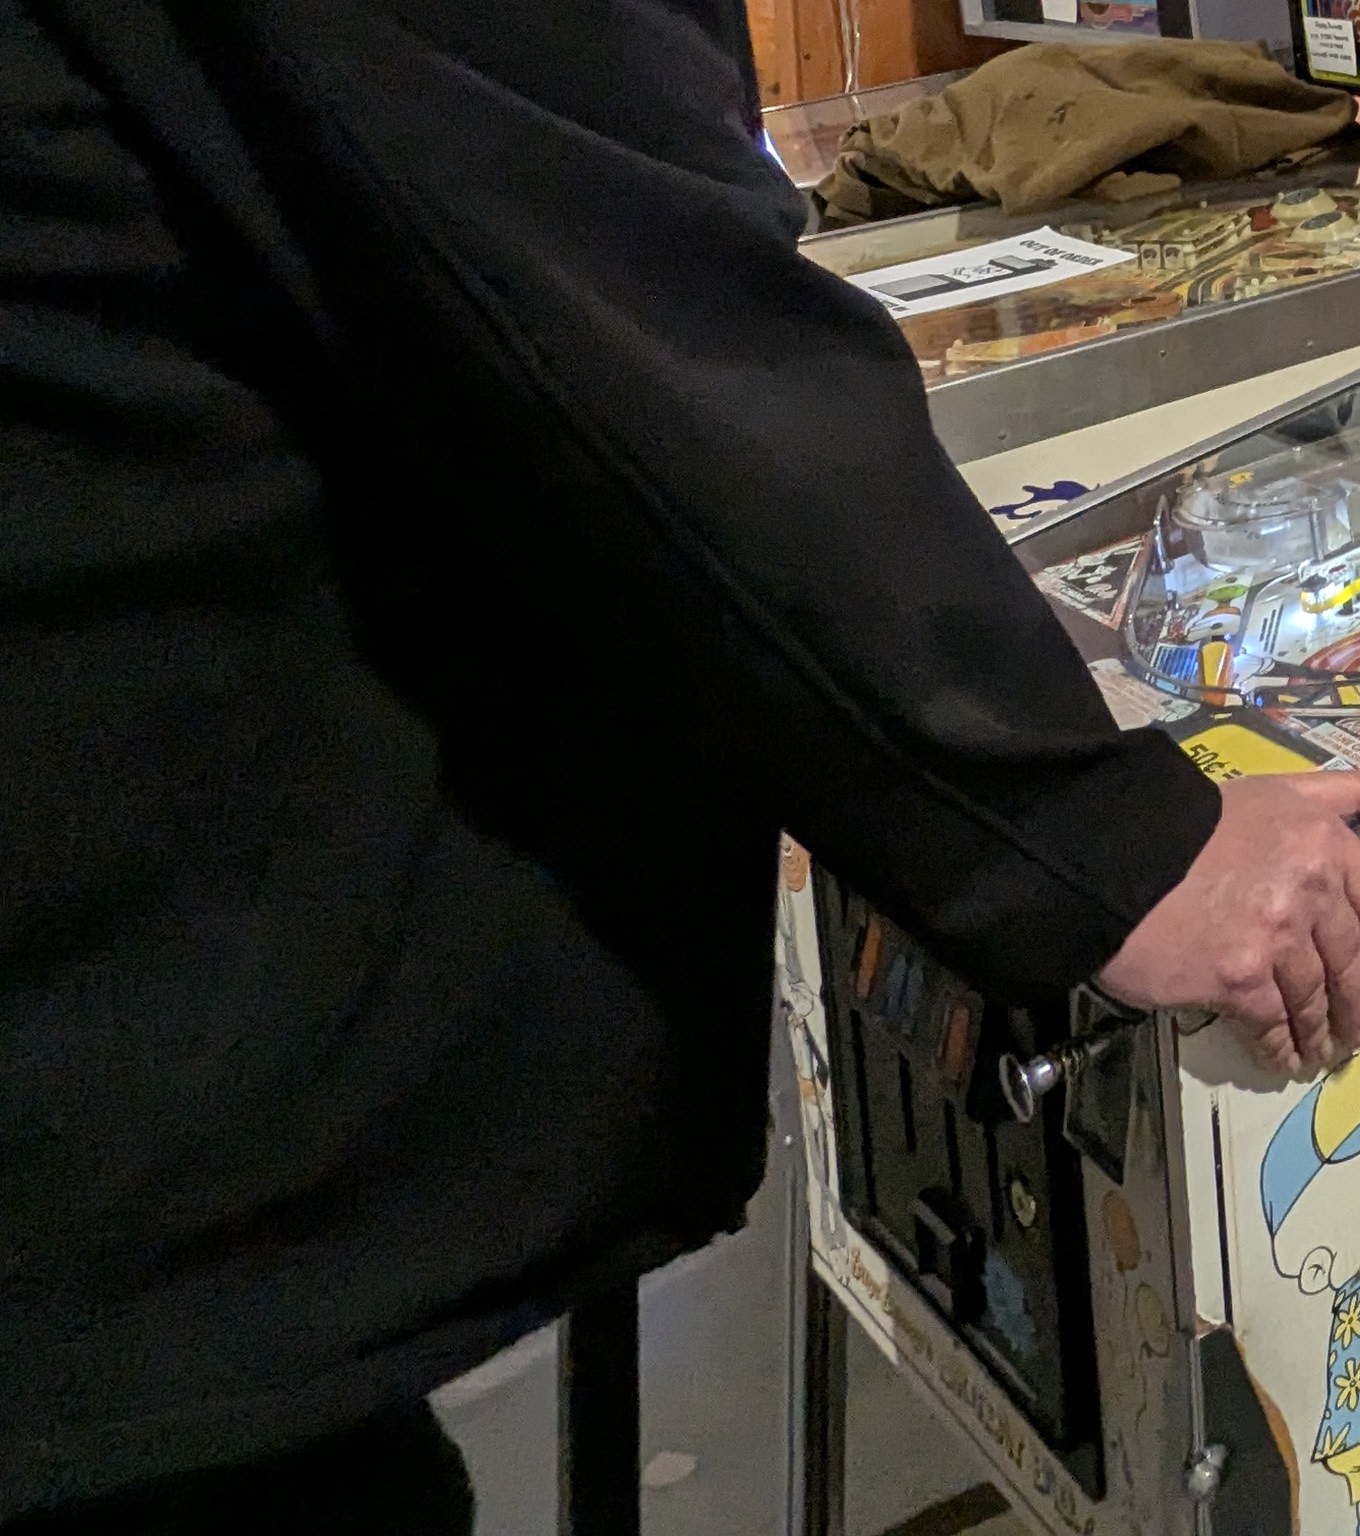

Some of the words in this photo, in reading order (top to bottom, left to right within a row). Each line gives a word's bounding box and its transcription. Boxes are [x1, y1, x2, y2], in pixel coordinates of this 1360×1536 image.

[1019, 239, 1050, 251] OUT
[1043, 247, 1067, 256] OF
[1059, 252, 1104, 266] ORDER
